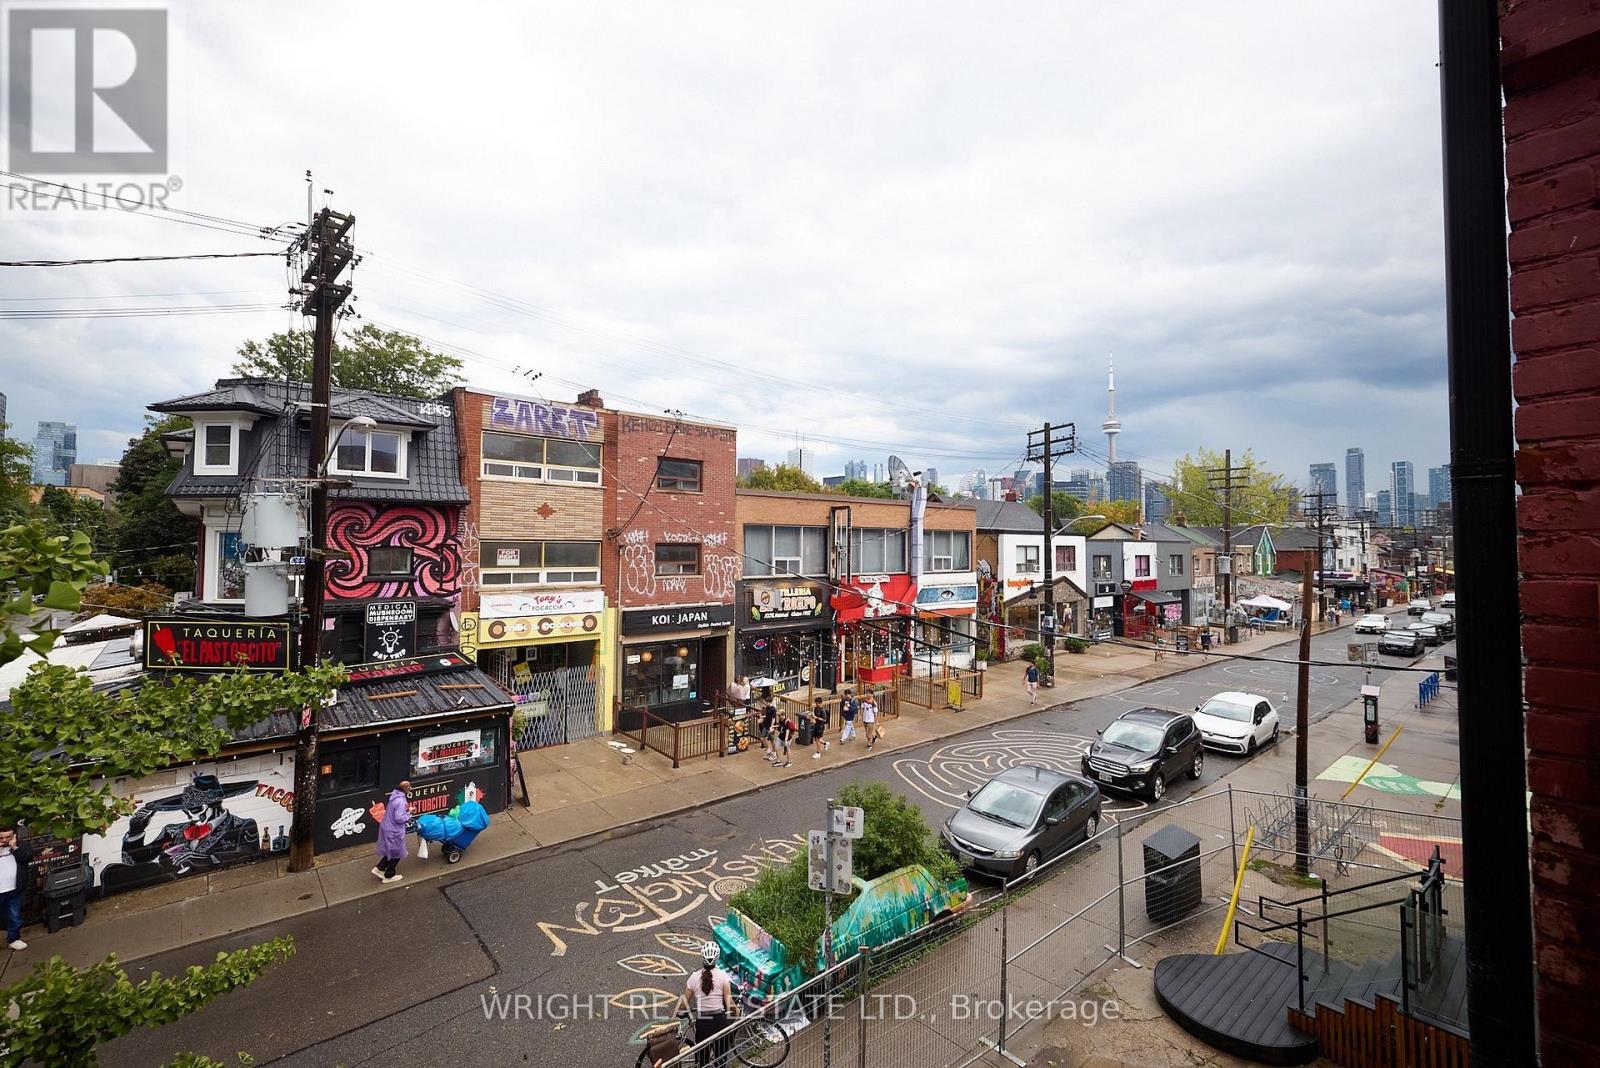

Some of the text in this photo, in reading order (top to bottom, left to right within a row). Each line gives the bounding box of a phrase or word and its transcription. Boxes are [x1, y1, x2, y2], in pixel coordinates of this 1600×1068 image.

[368, 609, 414, 617] MUSHROOM
[677, 611, 708, 625] JAPAN
[372, 648, 407, 660] DAY TRIP
